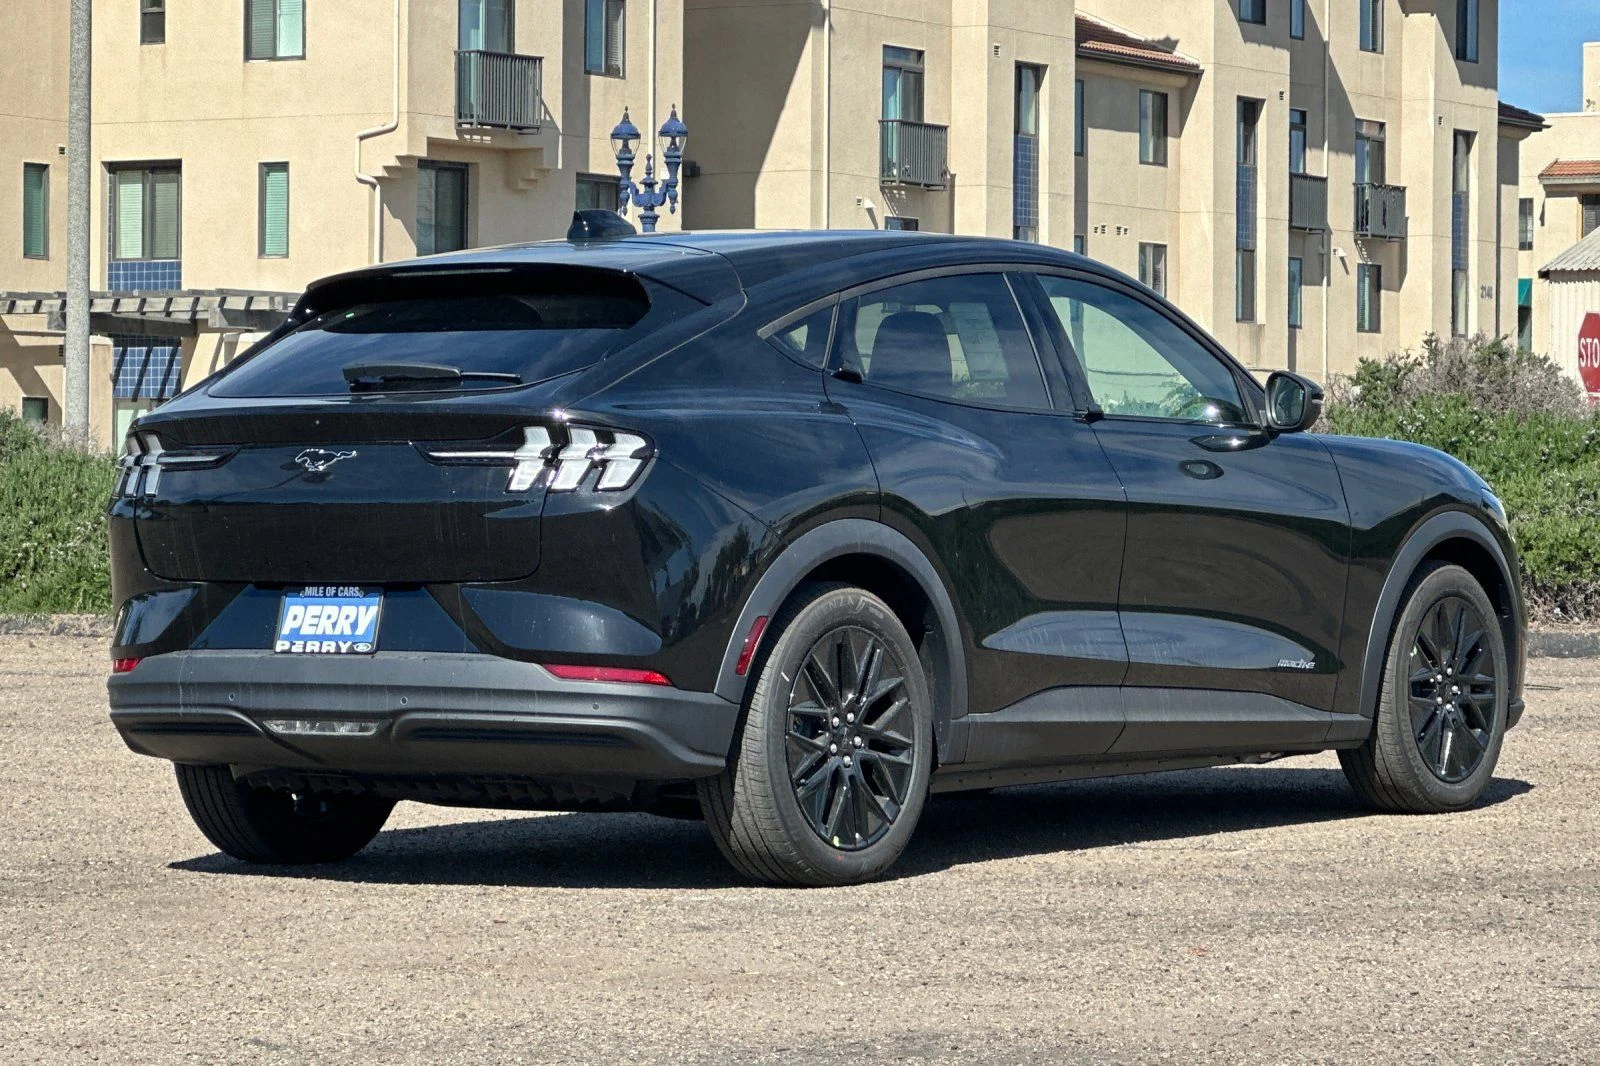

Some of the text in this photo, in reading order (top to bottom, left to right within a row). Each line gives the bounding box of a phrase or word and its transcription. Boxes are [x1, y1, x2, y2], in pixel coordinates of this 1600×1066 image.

[1579, 337, 1600, 368] STO
[304, 586, 360, 597] MILE OF CARS
[281, 605, 379, 635] PERRY
[275, 640, 352, 653] PERRY
